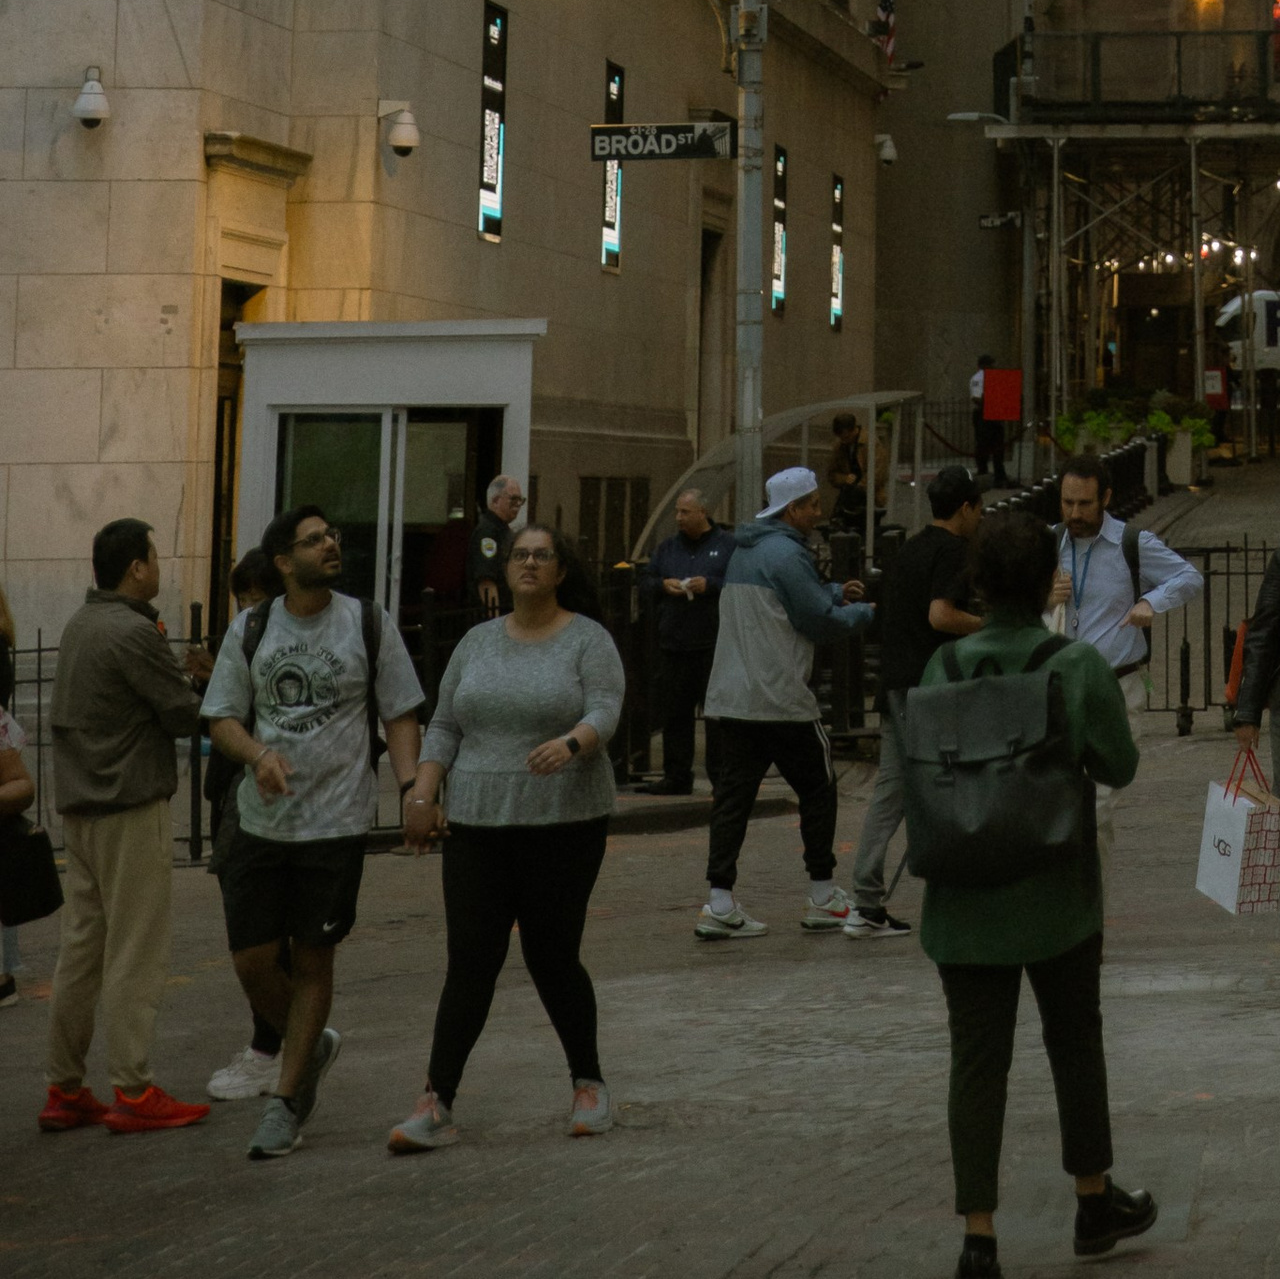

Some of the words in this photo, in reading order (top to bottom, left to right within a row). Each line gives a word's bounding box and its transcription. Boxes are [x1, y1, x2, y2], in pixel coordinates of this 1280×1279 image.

[594, 133, 677, 156] BROAD
[678, 133, 694, 145] ST
[1212, 834, 1232, 858] UGG
